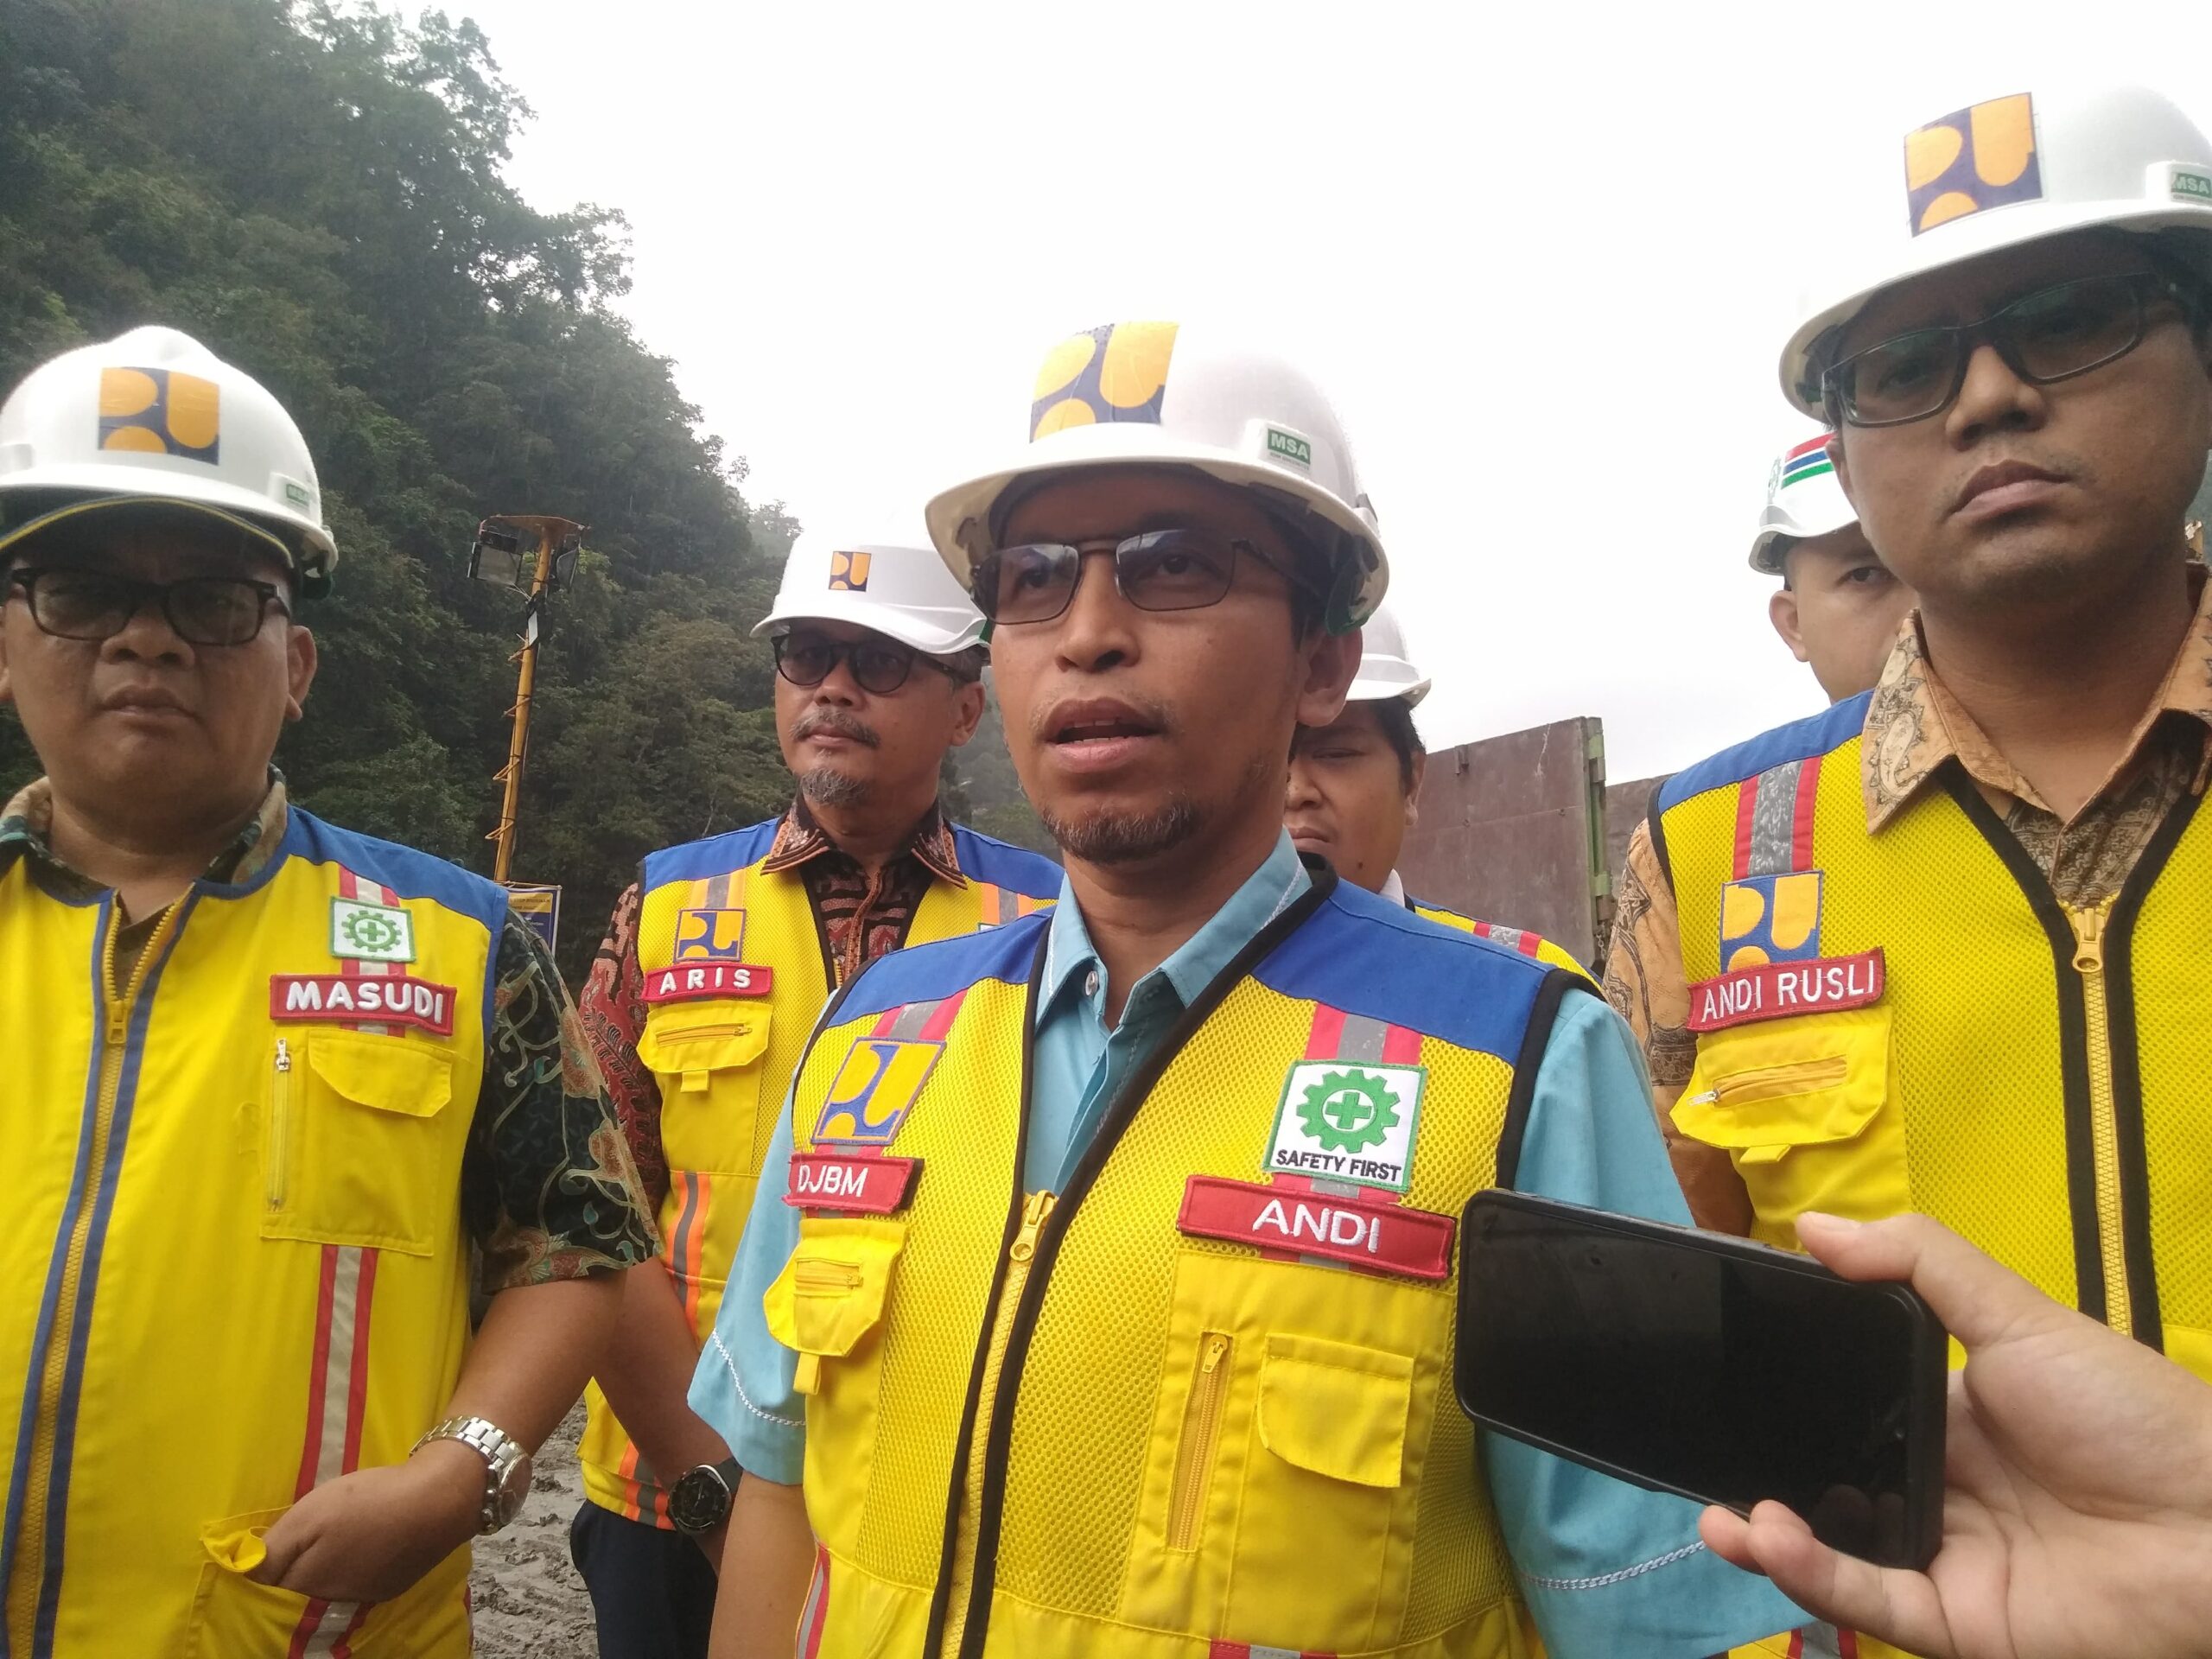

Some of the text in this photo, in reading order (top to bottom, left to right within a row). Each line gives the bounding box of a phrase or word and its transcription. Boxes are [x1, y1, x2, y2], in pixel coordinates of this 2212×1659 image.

[2177, 176, 2209, 194] MSA
[1271, 433, 1308, 460] MSA
[659, 967, 751, 995] ARIS
[1700, 959, 1874, 1023] ANDI RUSLI
[286, 981, 443, 1024] MASUDI
[798, 1164, 868, 1198] DJBM
[1276, 1149, 1402, 1181] SAFETY FIRST
[1252, 1198, 1380, 1253] ANDI
